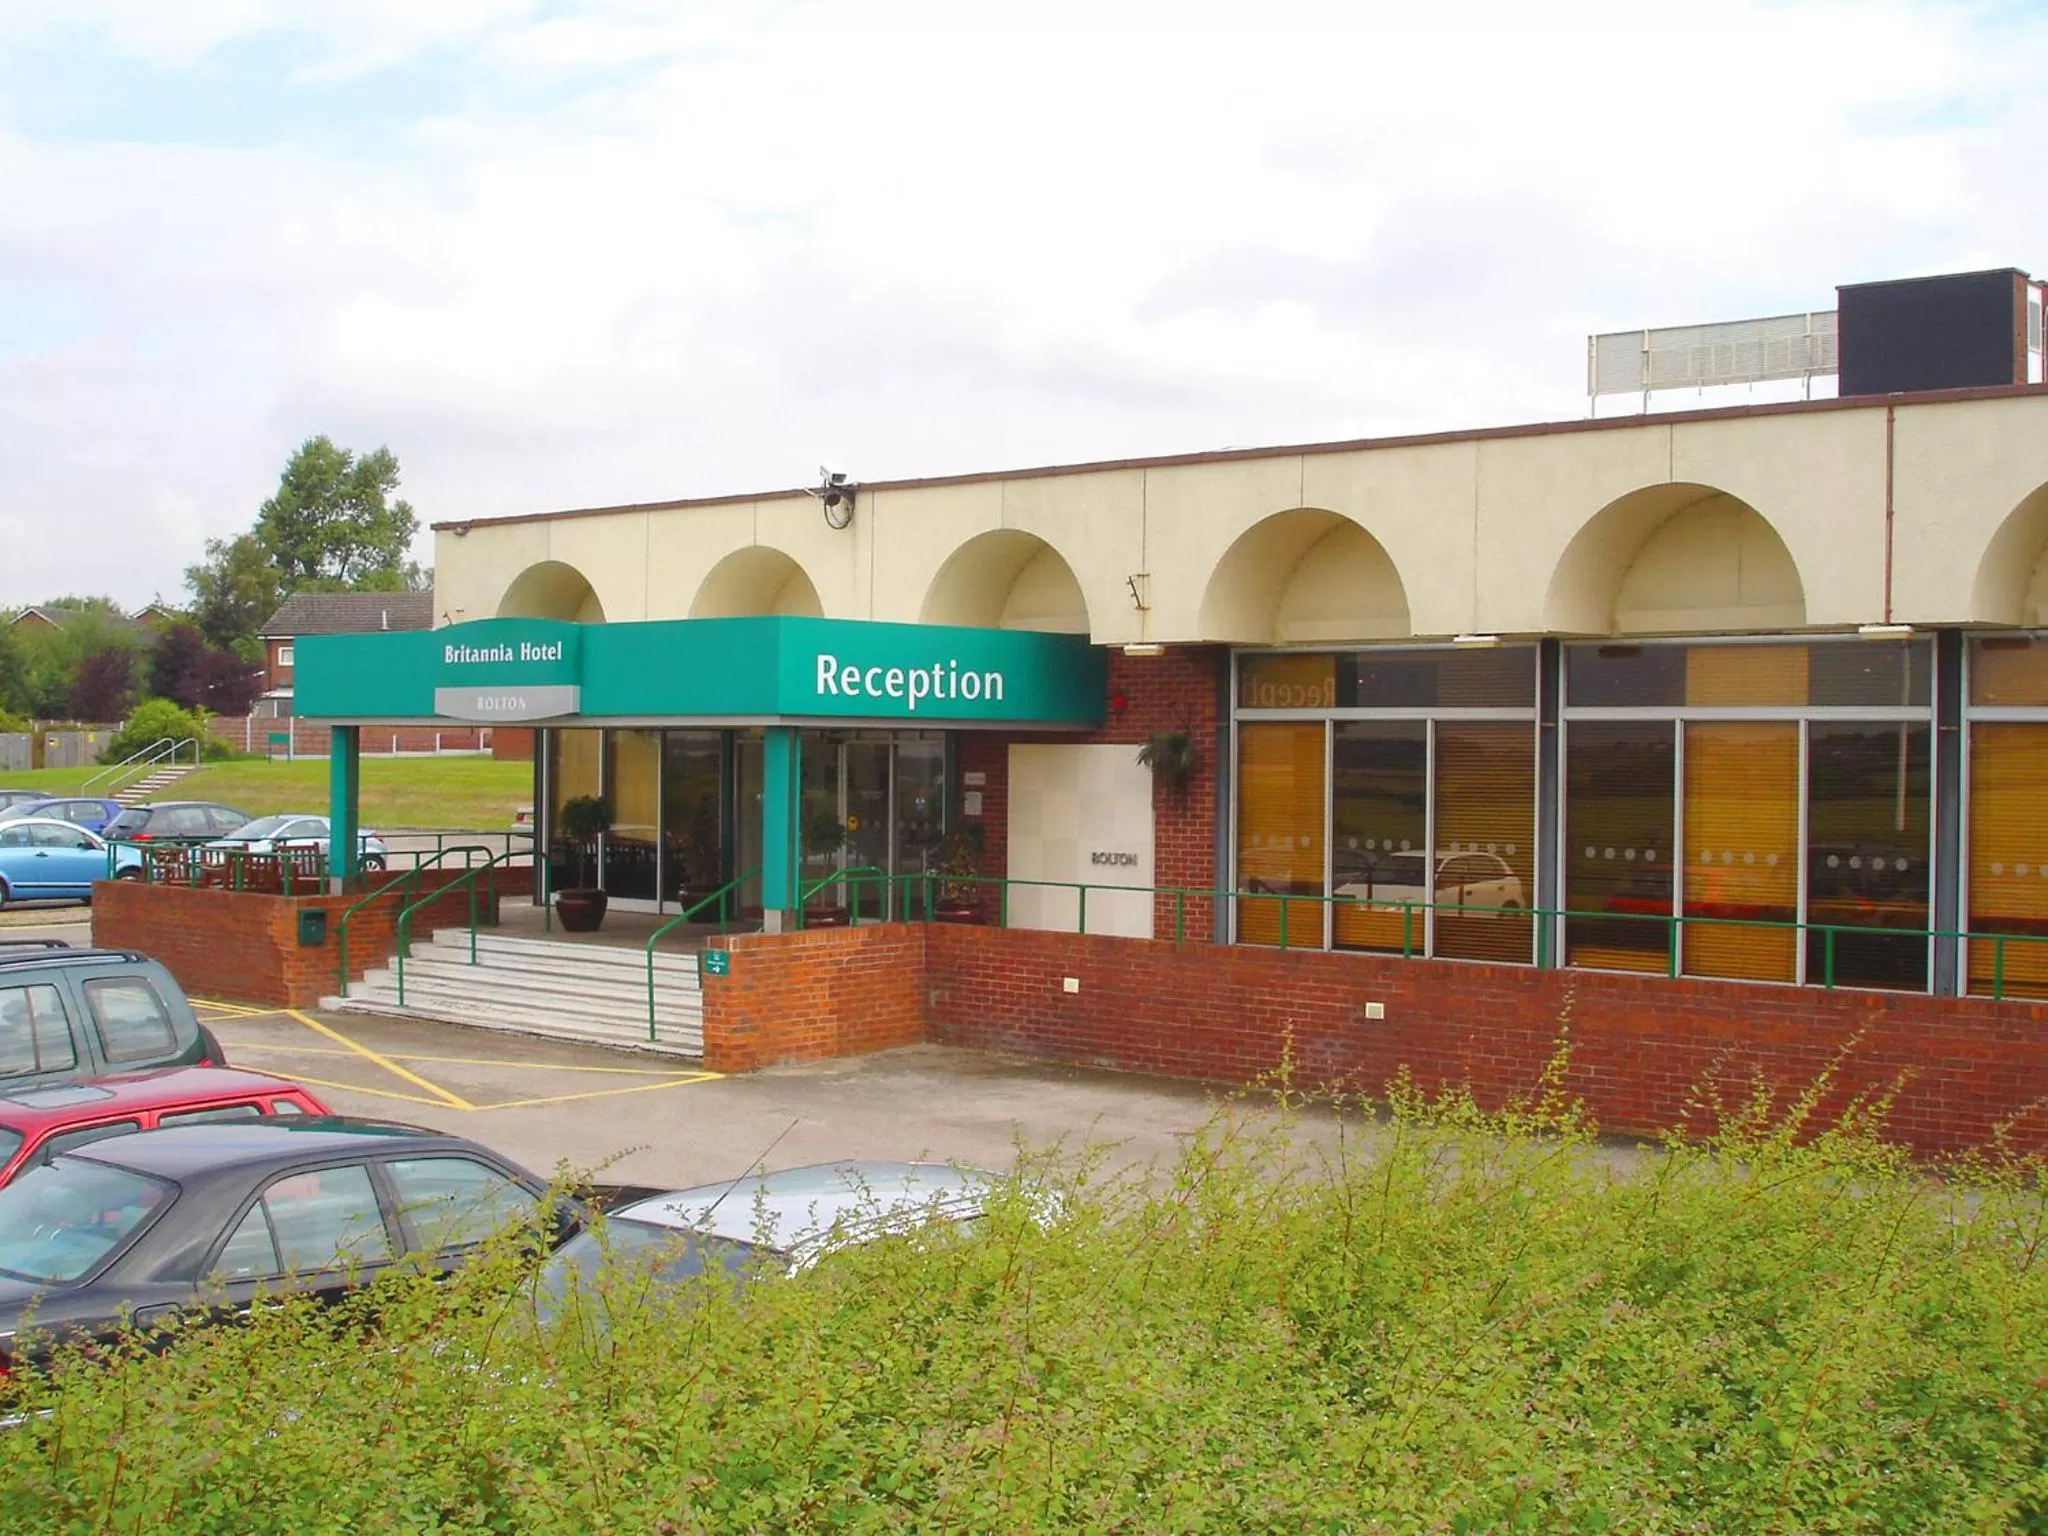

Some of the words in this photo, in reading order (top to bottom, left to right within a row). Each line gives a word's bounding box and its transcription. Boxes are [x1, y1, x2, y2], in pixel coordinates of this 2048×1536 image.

[445, 644, 513, 663] Britannia
[520, 640, 562, 661] Hotel
[816, 654, 1004, 710] Reception
[476, 697, 526, 711] BOLTON
[1091, 852, 1138, 866] BOLTON
